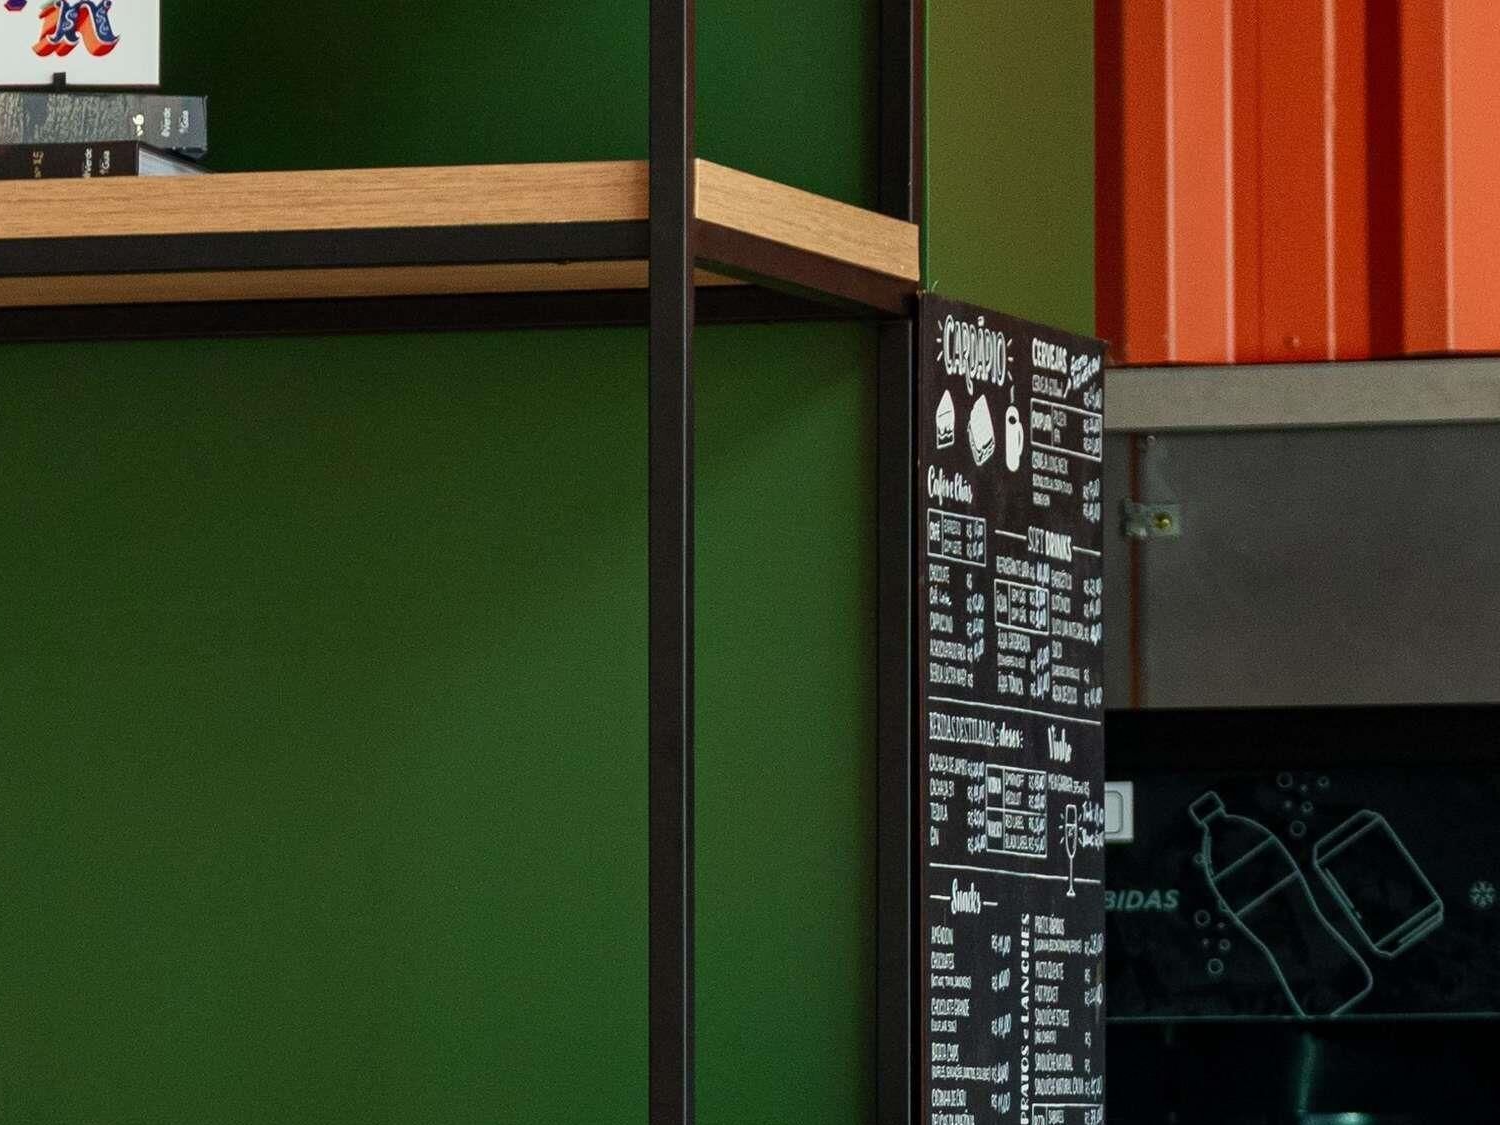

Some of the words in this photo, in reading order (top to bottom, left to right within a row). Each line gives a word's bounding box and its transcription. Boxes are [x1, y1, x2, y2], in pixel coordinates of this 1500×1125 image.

[943, 314, 1007, 396] CARDÁPIO
[1031, 337, 1068, 375] CERVEJAS
[1045, 531, 1073, 563] DRINKS
[1020, 912, 1030, 1024] LANCHES
